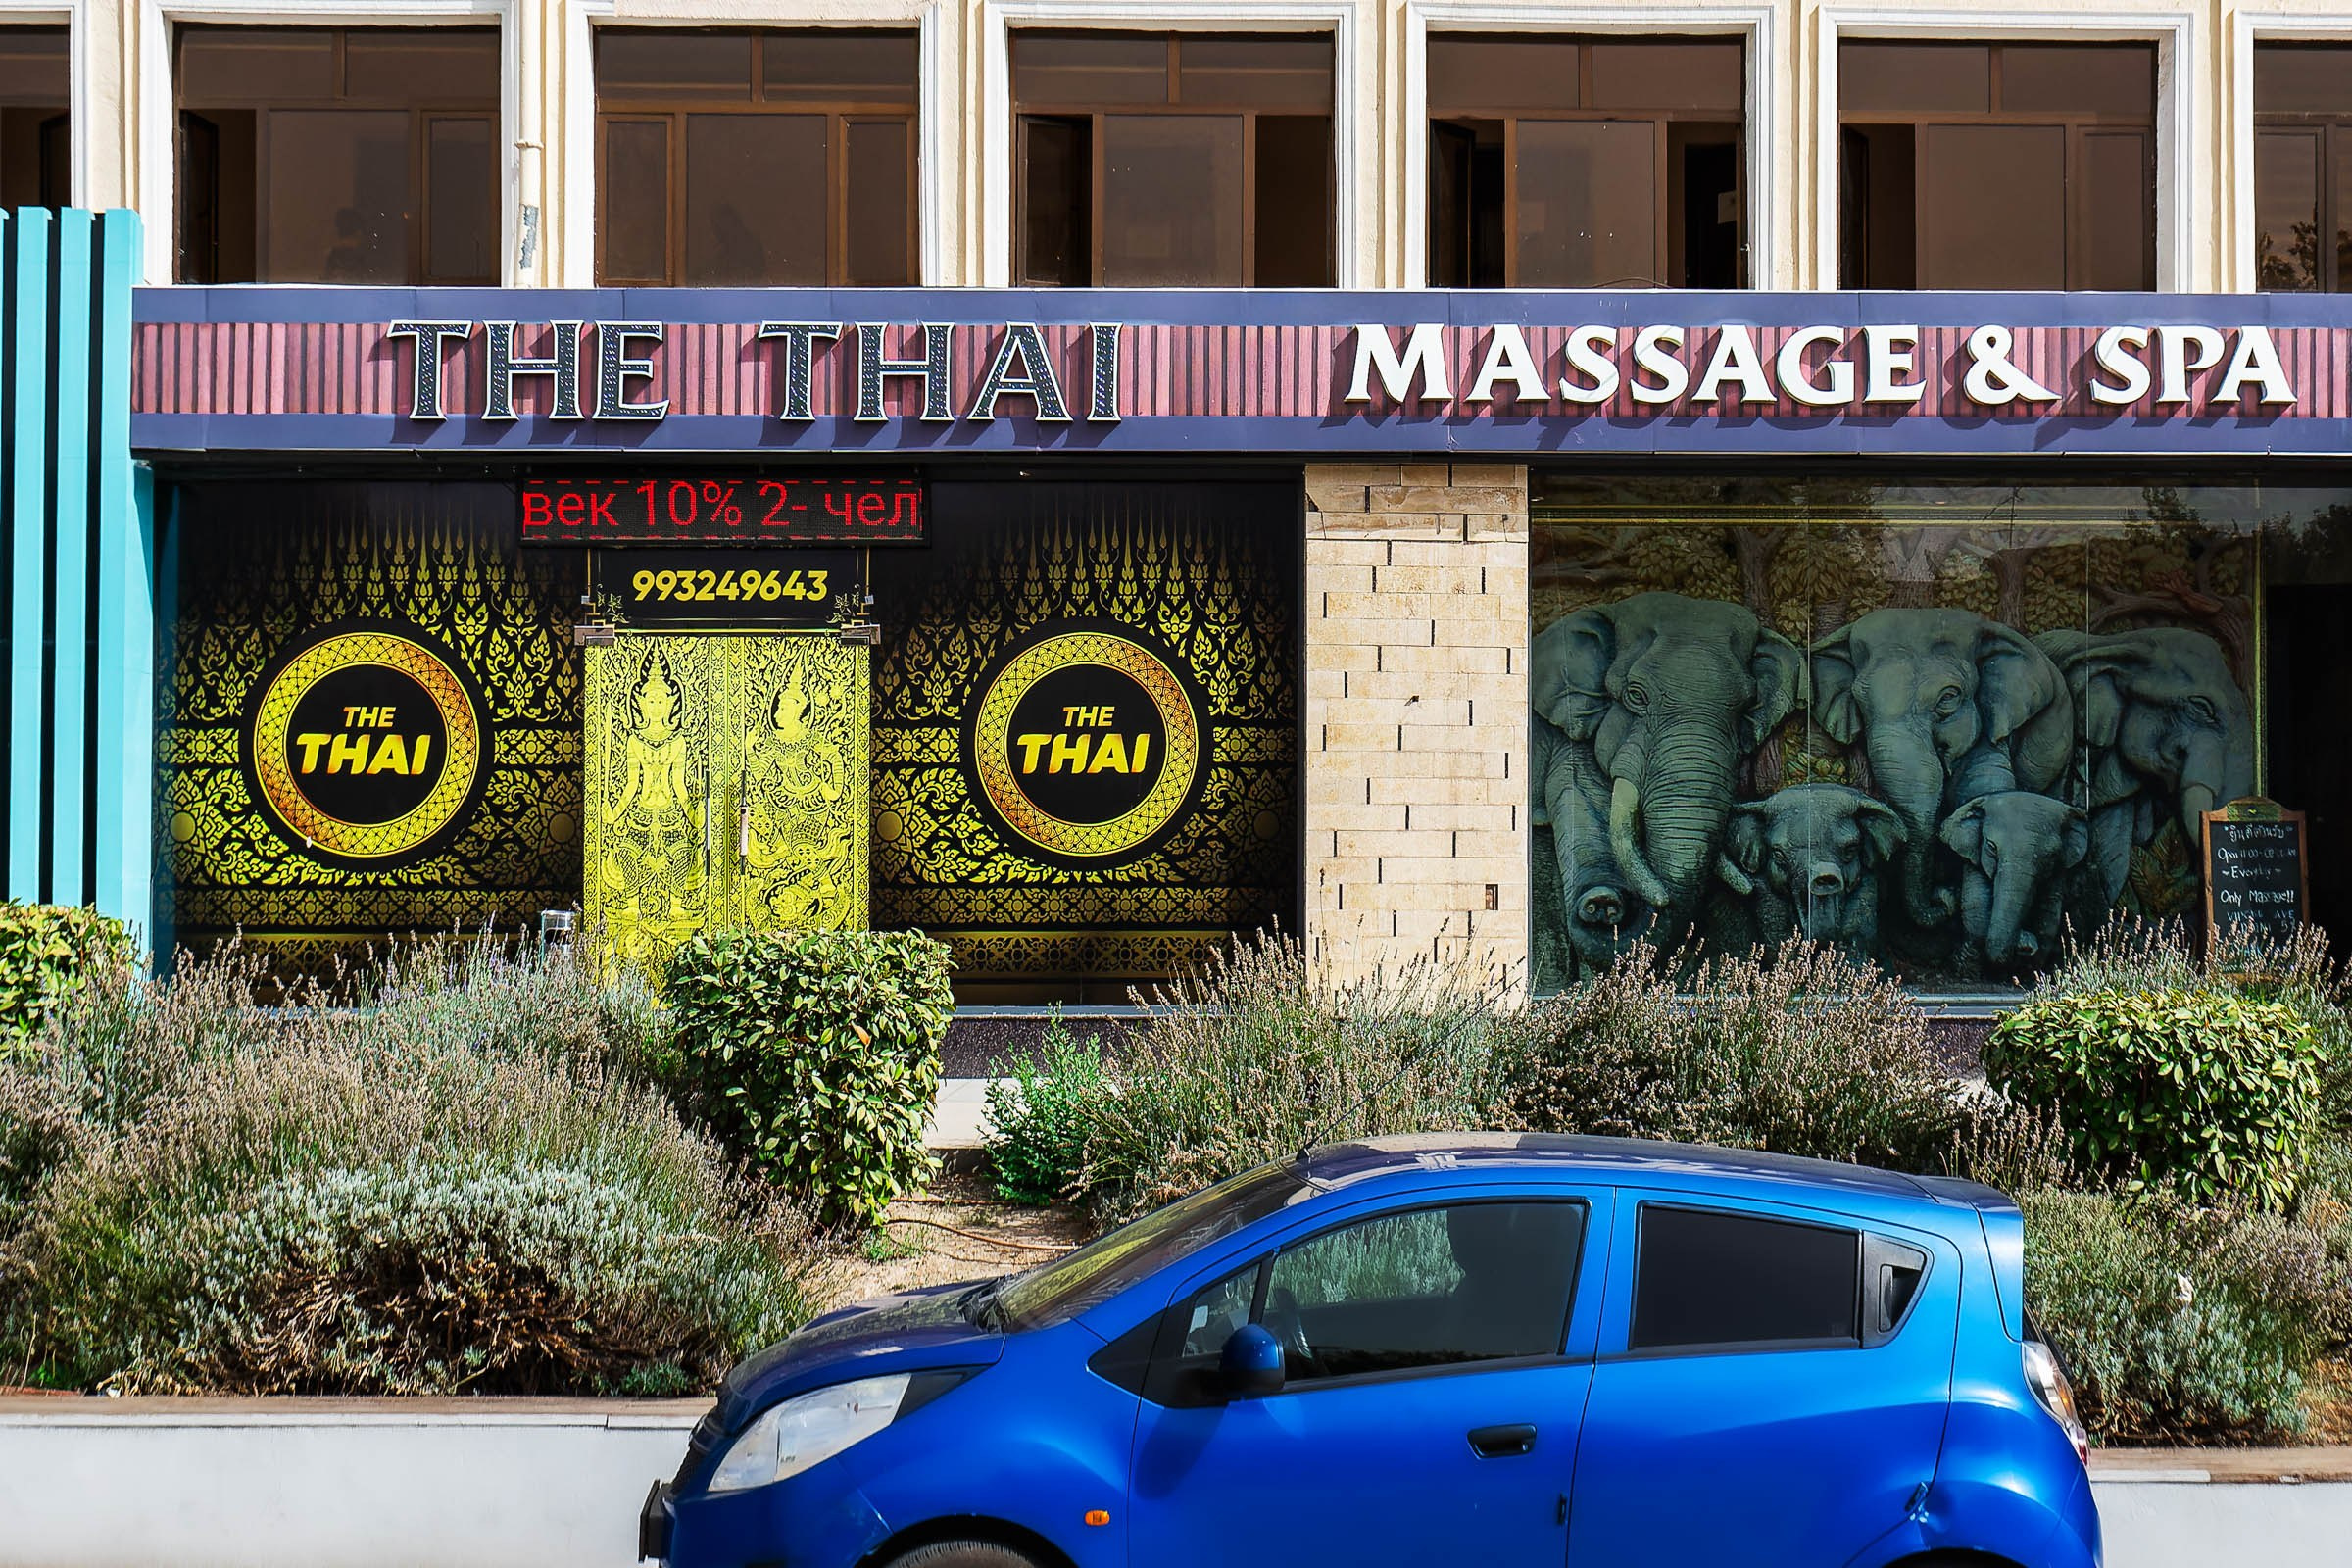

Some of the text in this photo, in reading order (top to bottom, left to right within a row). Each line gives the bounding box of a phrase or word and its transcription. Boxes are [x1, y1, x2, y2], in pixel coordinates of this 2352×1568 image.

[386, 320, 2298, 422] THE THAI MASSAGE & SPA
[523, 492, 619, 526] век
[637, 482, 743, 526] 10%
[824, 492, 918, 526] чел
[632, 570, 828, 601] 993249643
[343, 706, 396, 728] THE
[1062, 706, 1115, 727] THE
[296, 733, 431, 775] THAI
[1017, 733, 1151, 774] THAI
[2220, 889, 2242, 907] Only
